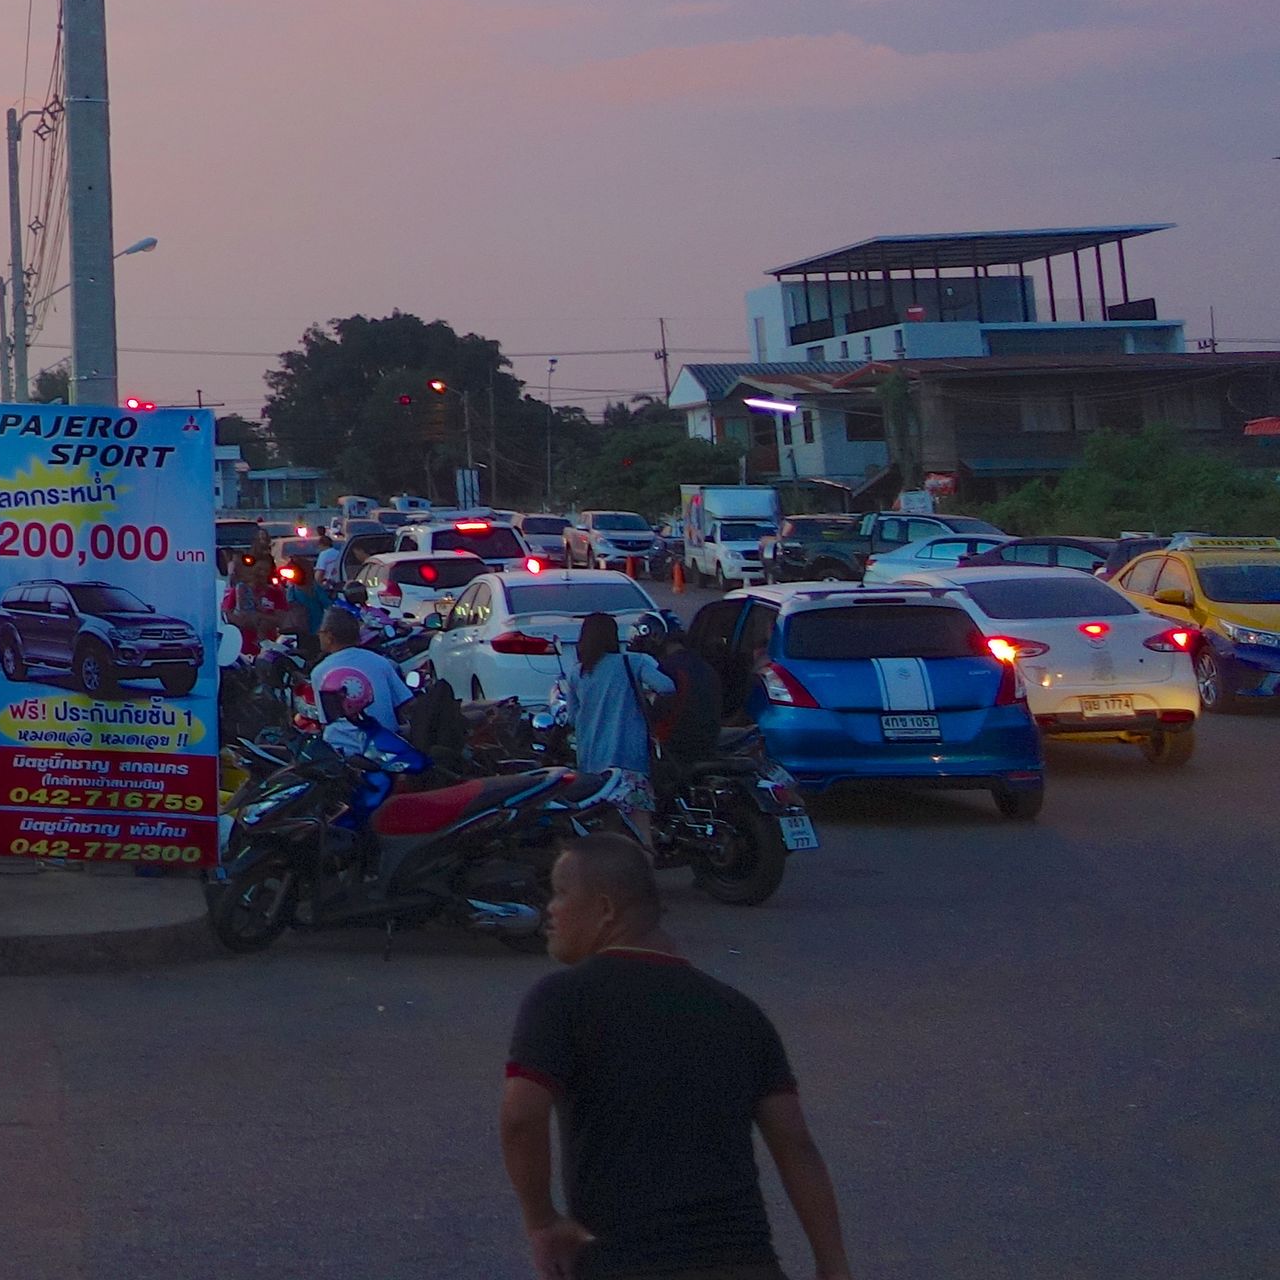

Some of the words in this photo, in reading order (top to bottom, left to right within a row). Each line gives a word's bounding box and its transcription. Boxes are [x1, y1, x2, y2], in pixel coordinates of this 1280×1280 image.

[48, 443, 175, 468] SPORT
[175, 549, 205, 563] บาท
[9, 698, 47, 721] ฟรี!
[55, 696, 175, 726] ประกันภัยชั้น
[183, 711, 192, 727] 1
[909, 717, 935, 727] 1057
[18, 727, 92, 747] หมดแล้ว
[101, 731, 170, 748] หมดเลย
[119, 760, 189, 776] สกลนคร
[8, 787, 204, 813] 042-716759
[130, 820, 187, 839] พังโคน
[9, 837, 203, 863] 042-772300
